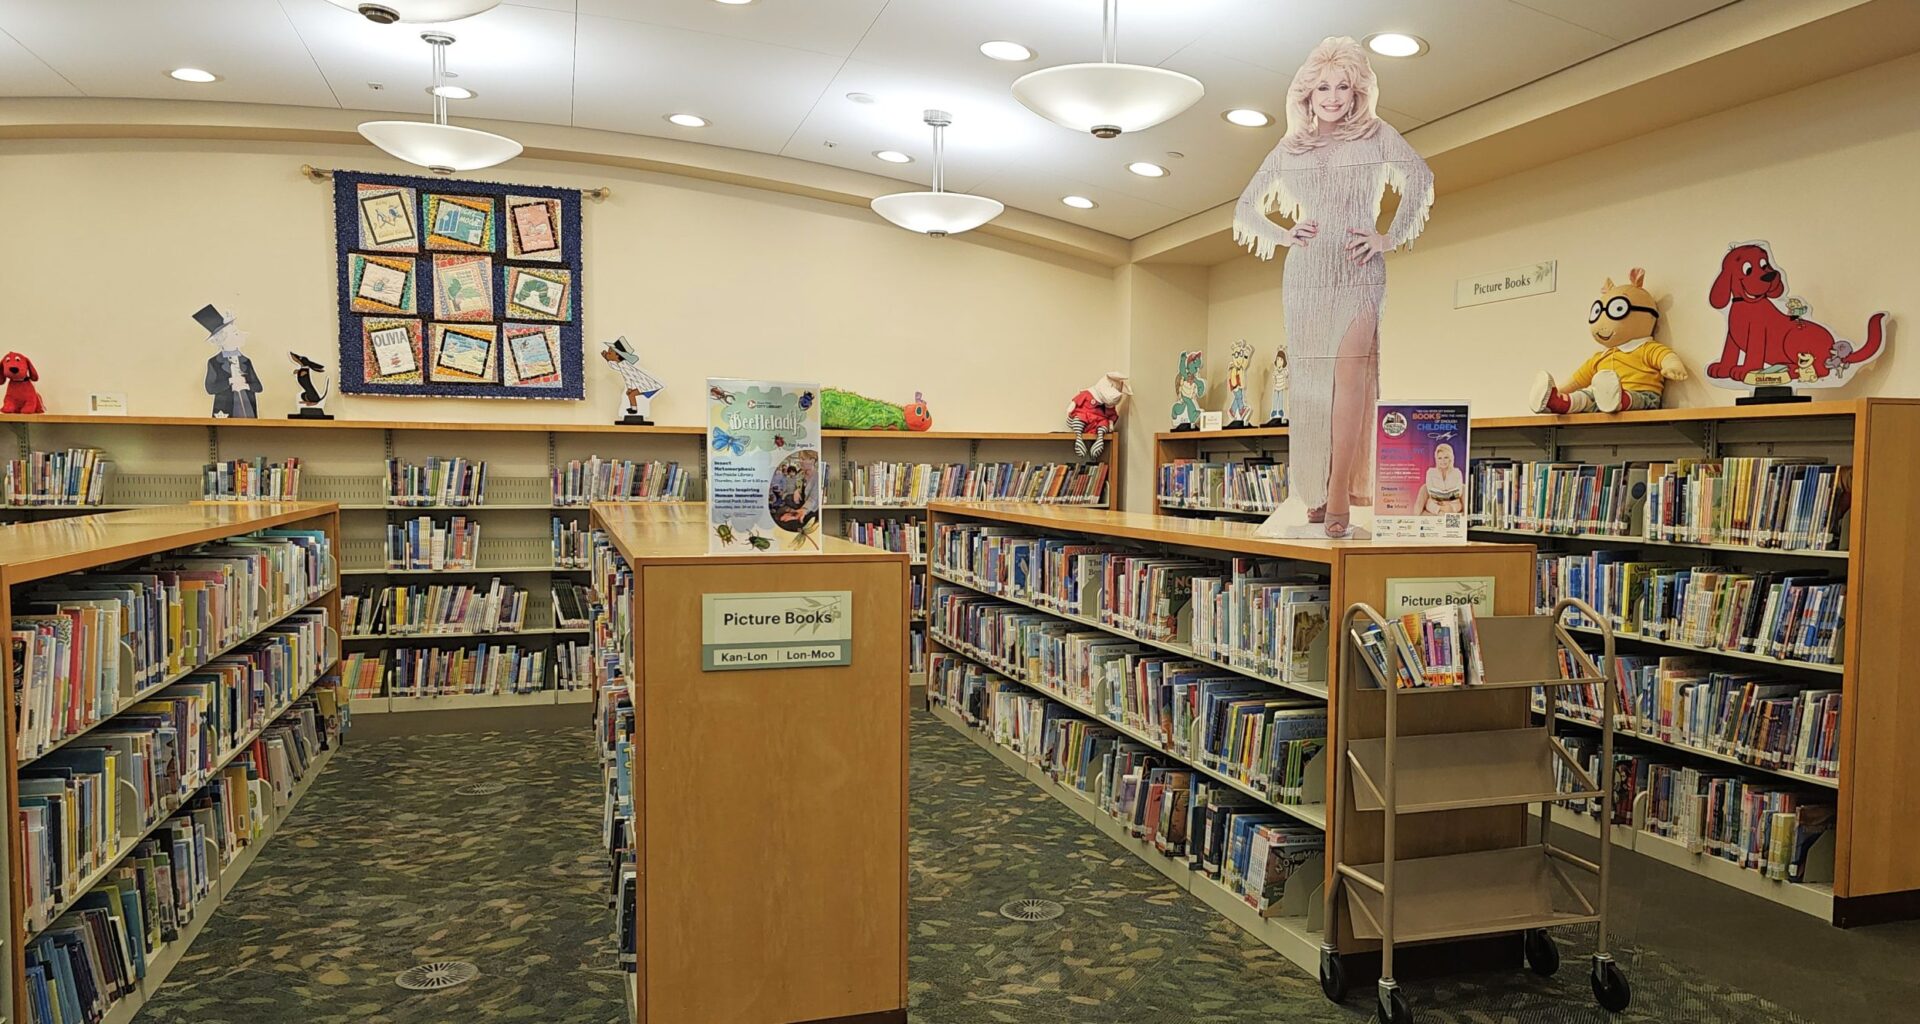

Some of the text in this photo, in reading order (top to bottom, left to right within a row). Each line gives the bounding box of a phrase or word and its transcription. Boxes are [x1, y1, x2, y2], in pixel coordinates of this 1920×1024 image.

[1474, 274, 1531, 295] Picture Books
[374, 331, 408, 347] OLIVIA
[730, 411, 799, 437] Beetlelady
[1401, 594, 1480, 607] Picture Books
[724, 611, 832, 626] Picture Books
[721, 650, 835, 662] Kan-Lon Lon-Moo
